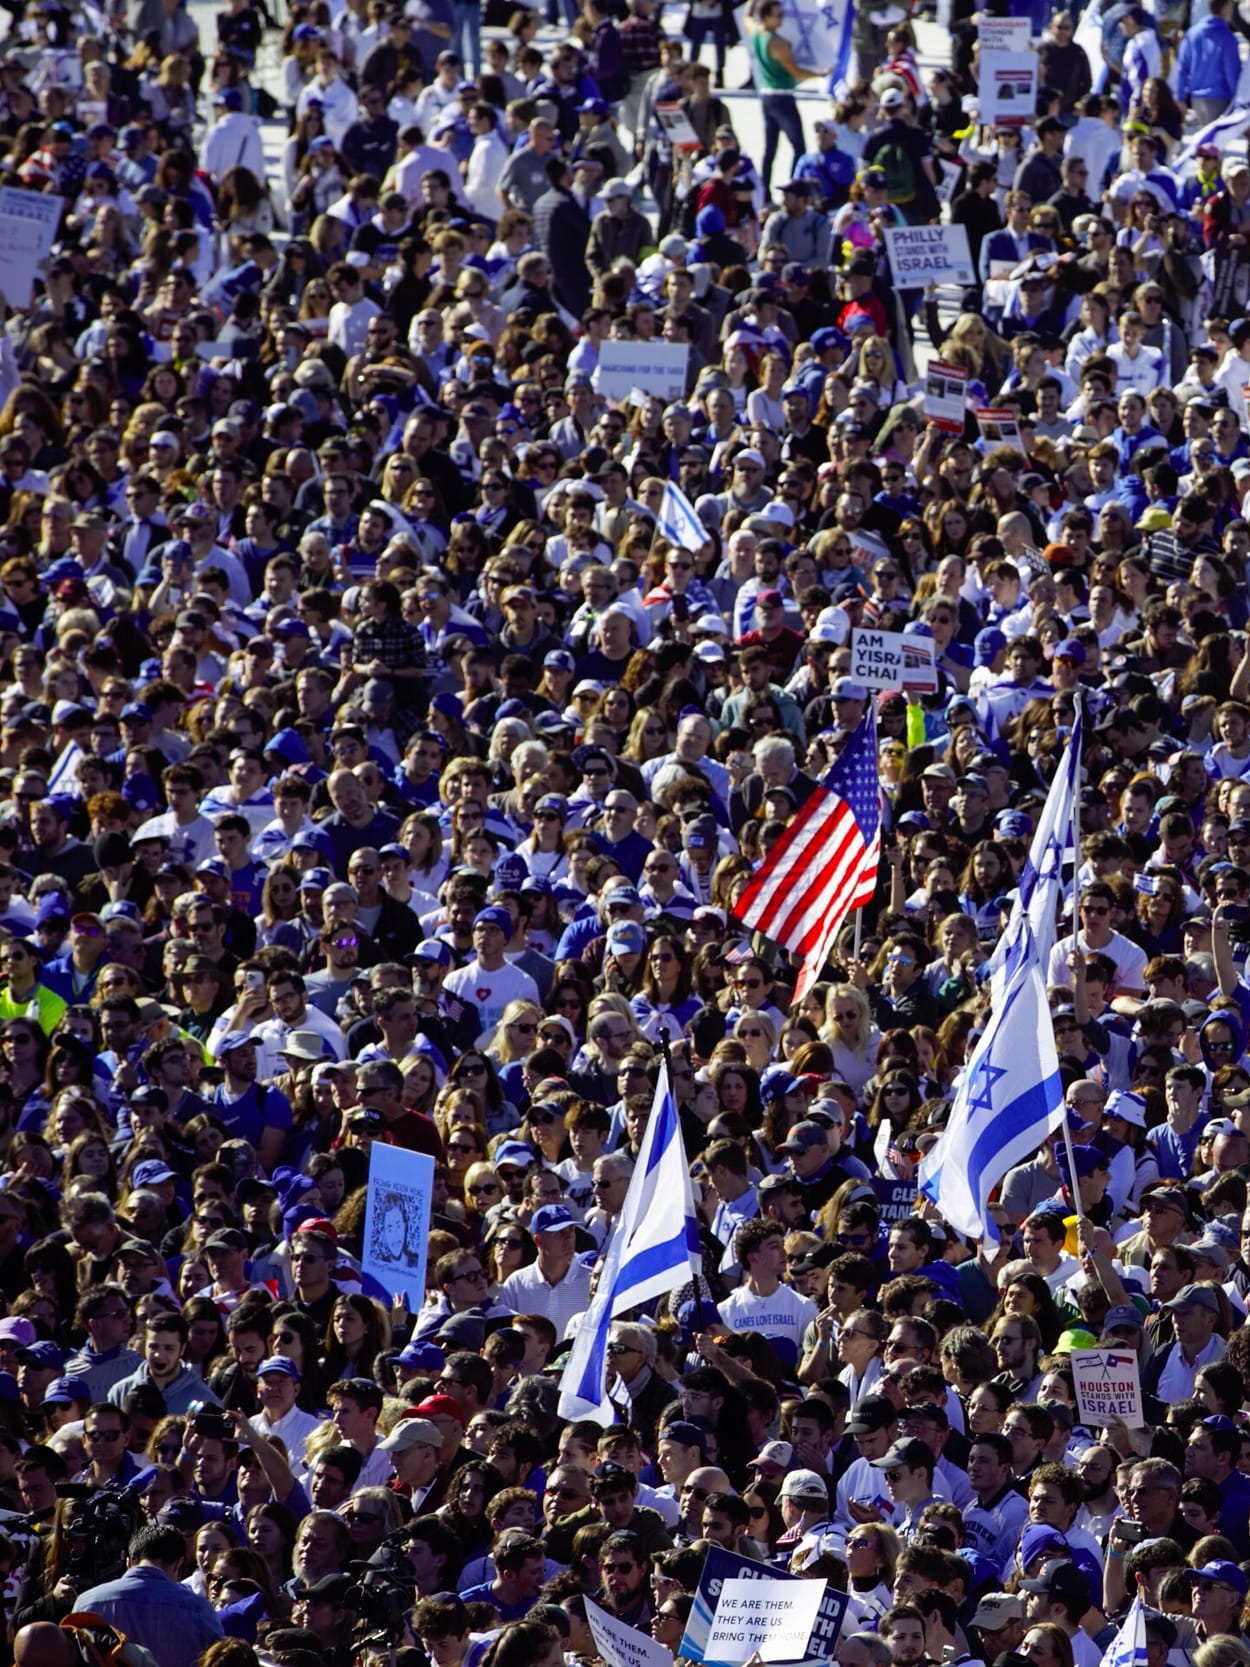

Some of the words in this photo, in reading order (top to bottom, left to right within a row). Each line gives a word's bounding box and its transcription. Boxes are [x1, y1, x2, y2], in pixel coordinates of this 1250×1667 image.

[892, 229, 944, 244] PHILLY
[897, 256, 953, 272] ISRAEL
[857, 634, 883, 648] AM
[856, 664, 897, 681] CHAI
[756, 1314, 772, 1326] LOVE
[772, 1314, 796, 1326] ISRAEL
[1080, 1381, 1134, 1393] HOUSTON
[1080, 1391, 1112, 1401] STANDS
[1114, 1392, 1136, 1400] WITH
[1082, 1399, 1137, 1415] ISRAEL
[722, 1600, 737, 1608] WE
[741, 1600, 761, 1609] ARE
[765, 1600, 794, 1610] THEM.
[718, 1615, 744, 1625] THEY
[746, 1617, 767, 1626] ARE
[770, 1618, 785, 1627] US.
[712, 1631, 745, 1642] BRING
[620, 1637, 650, 1659] THEM.
